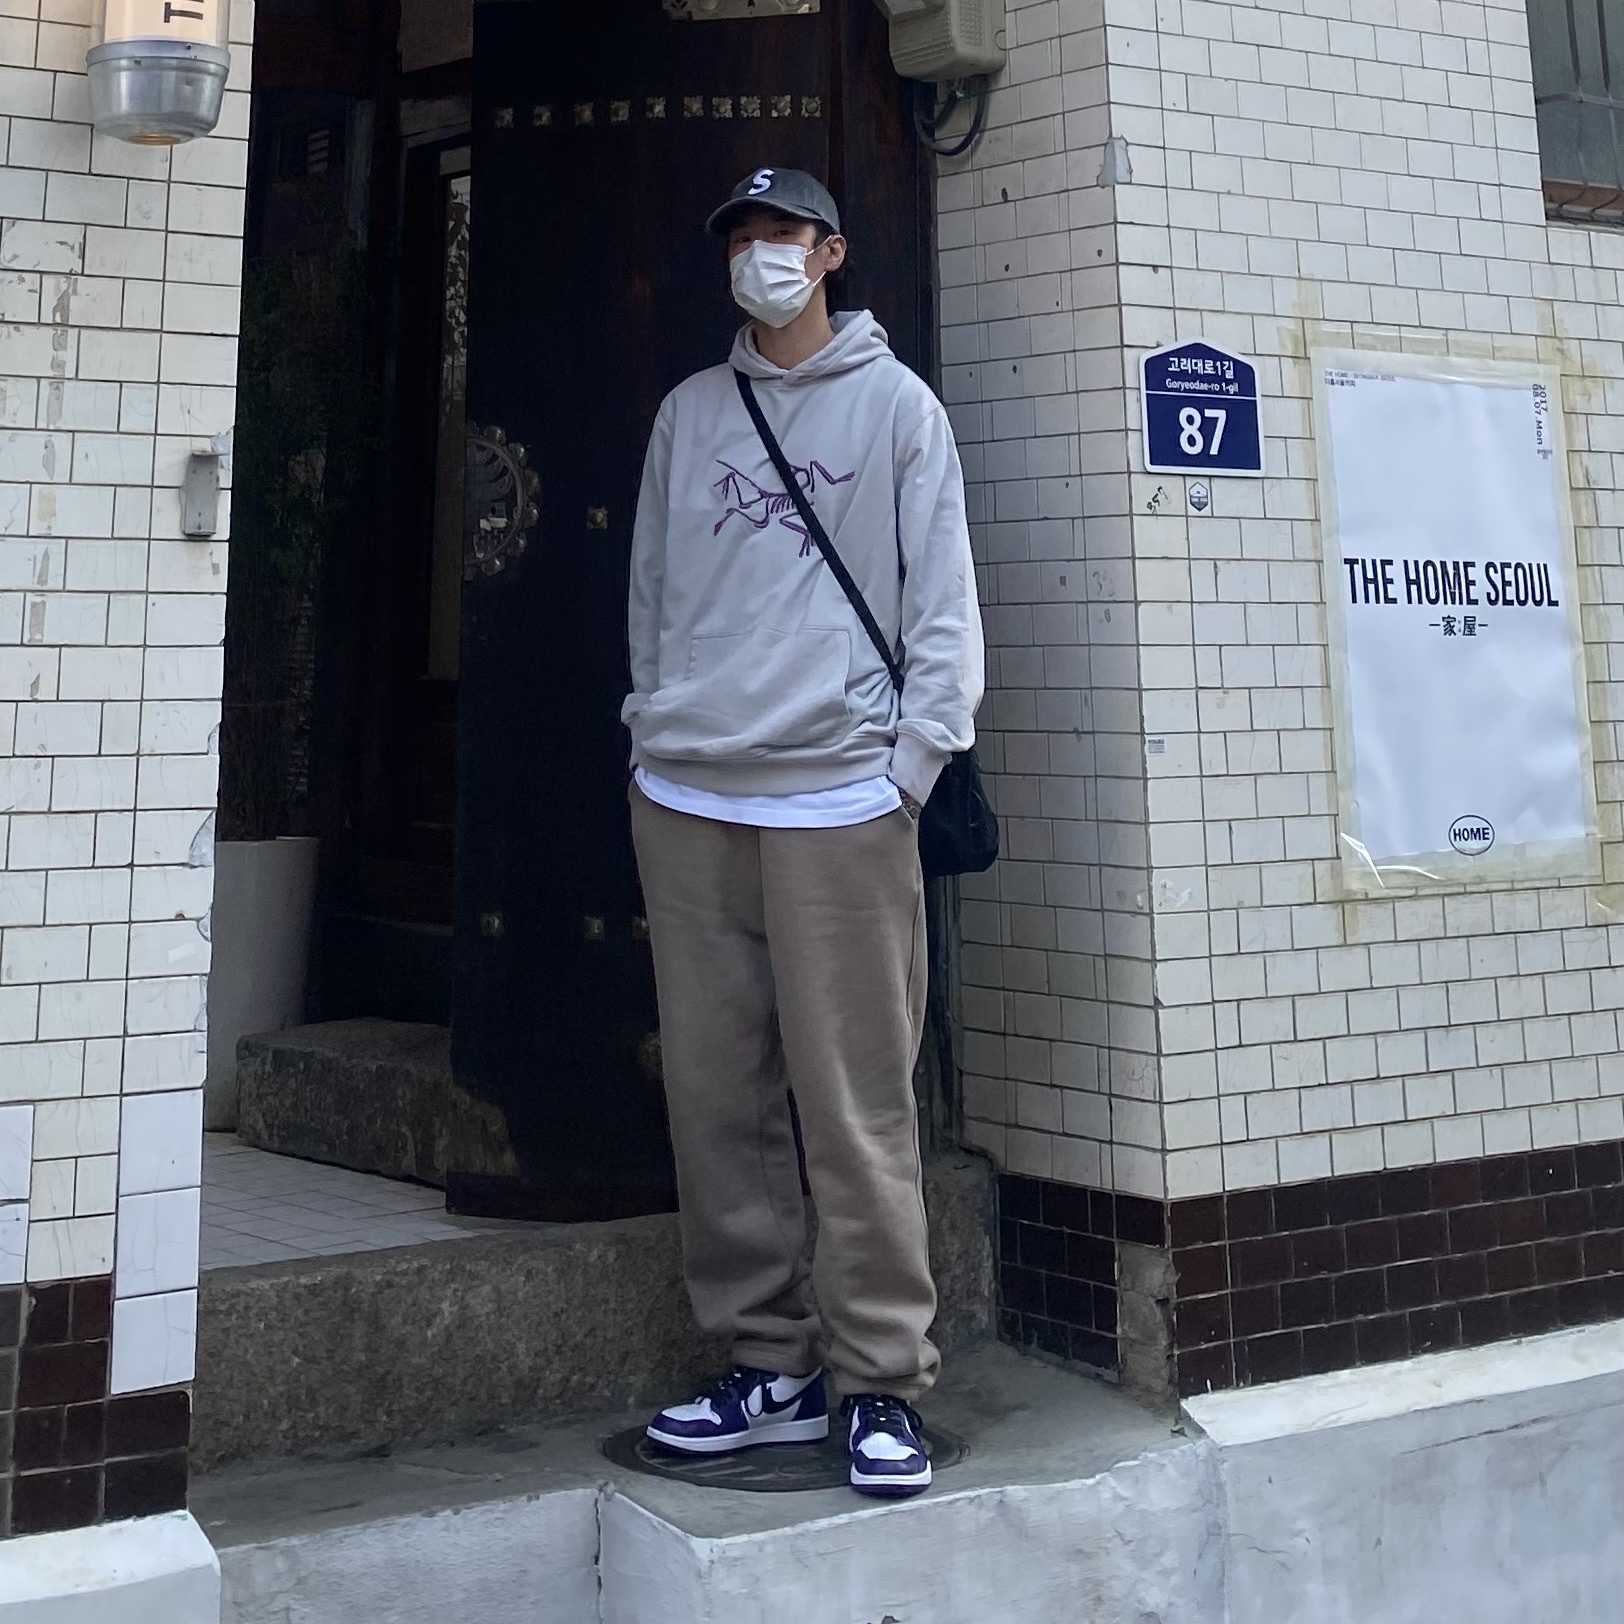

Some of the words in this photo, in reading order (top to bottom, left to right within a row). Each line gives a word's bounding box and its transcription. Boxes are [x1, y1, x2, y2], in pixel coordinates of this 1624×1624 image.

[747, 169, 775, 196] S
[1167, 357, 1235, 379] 고려대로1길
[1165, 377, 1220, 392] Goryeodae-ro
[1221, 381, 1240, 395] 1-gil
[1539, 384, 1549, 413] 2017
[1178, 406, 1228, 456] 87
[1343, 557, 1398, 605] THE
[1402, 559, 1479, 606] HOME
[1484, 561, 1559, 607] SEOUL
[1452, 827, 1491, 842] HOME
